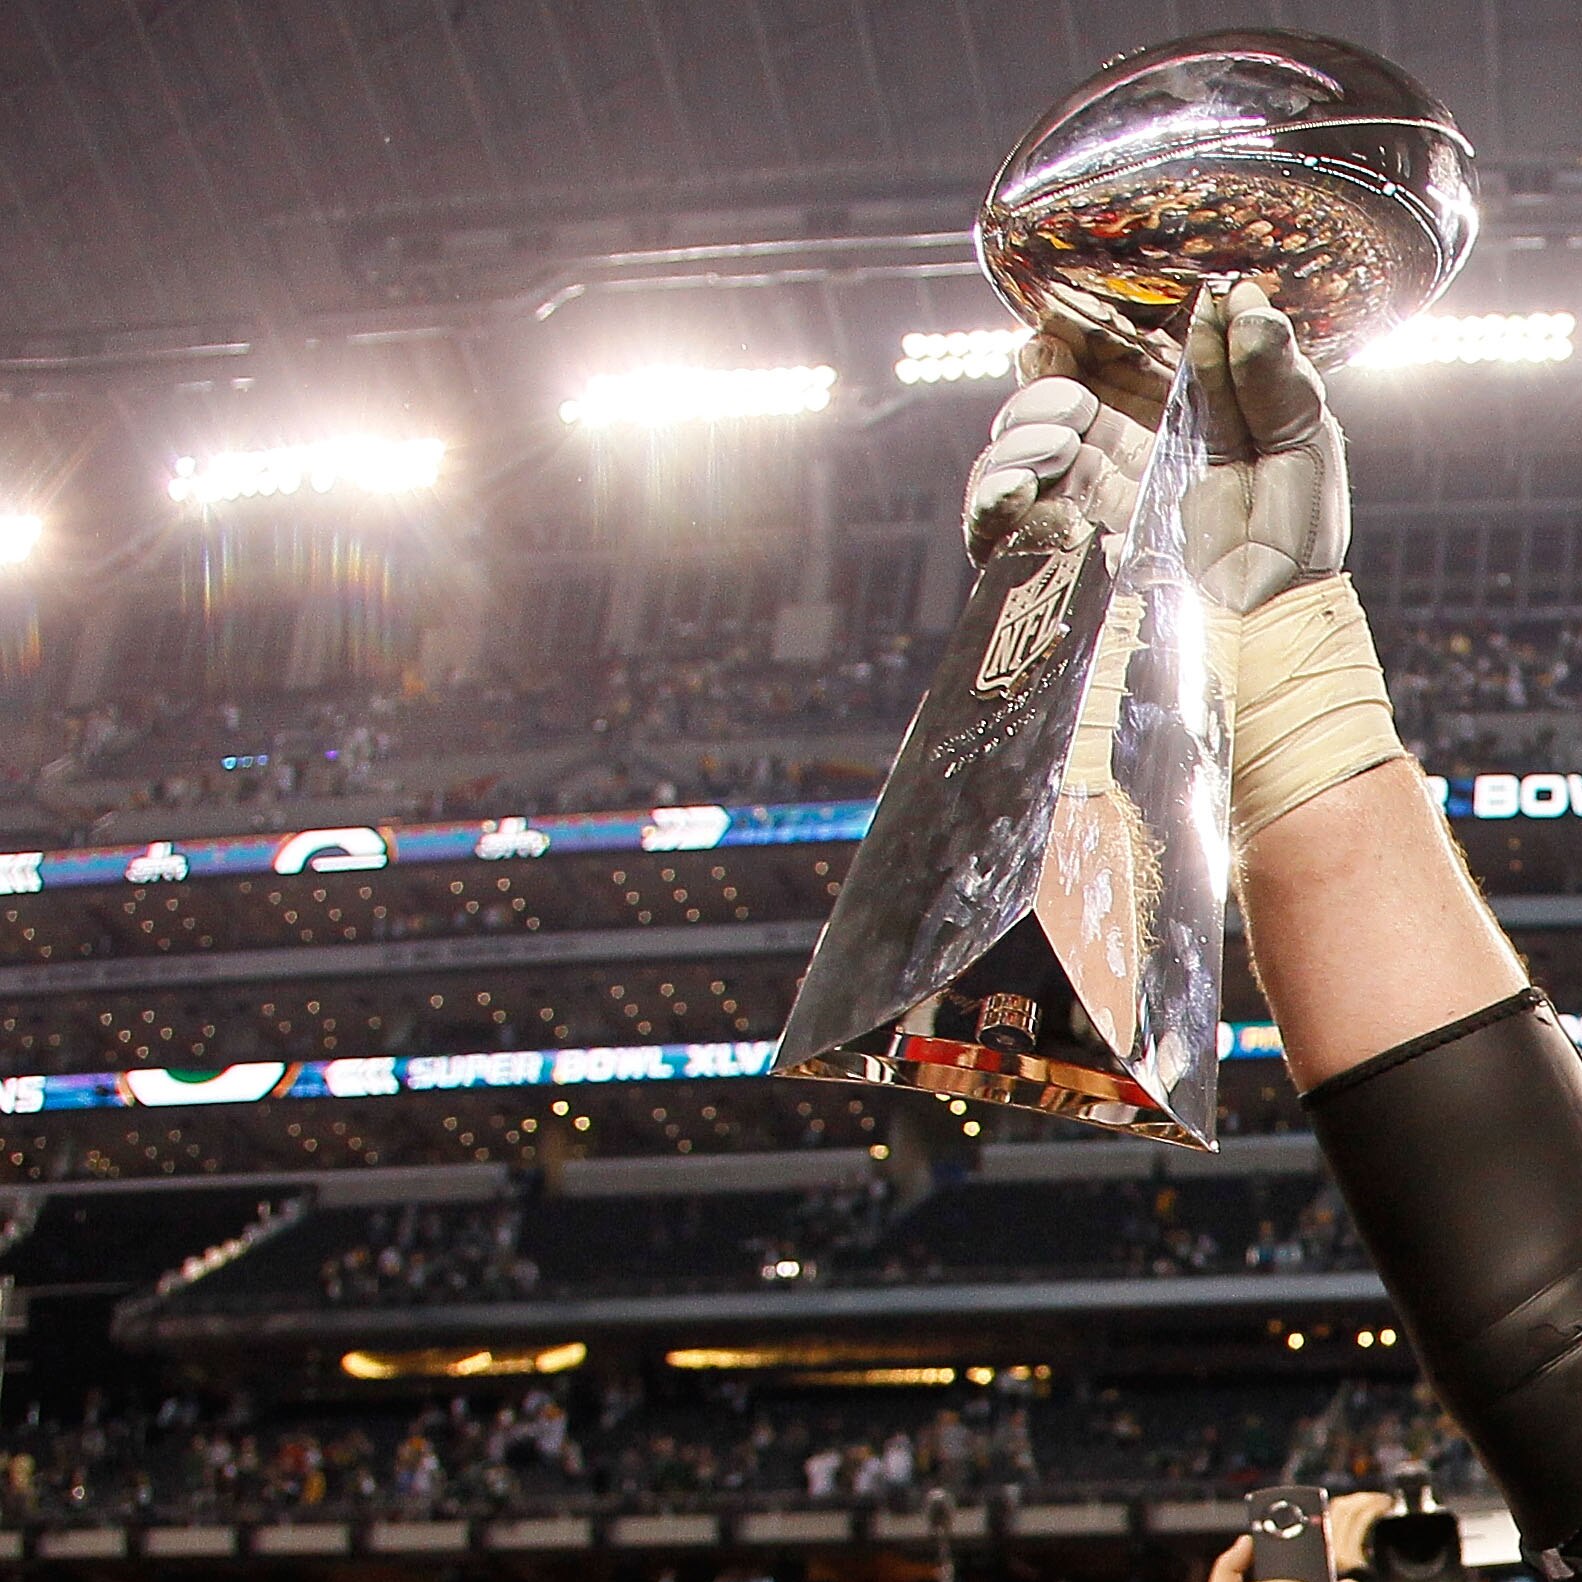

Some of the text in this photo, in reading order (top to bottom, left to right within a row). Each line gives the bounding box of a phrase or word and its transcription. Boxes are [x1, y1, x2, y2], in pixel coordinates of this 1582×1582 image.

[985, 590, 1062, 679] NFL
[407, 1040, 772, 1091] SUPER BOWL XLV
